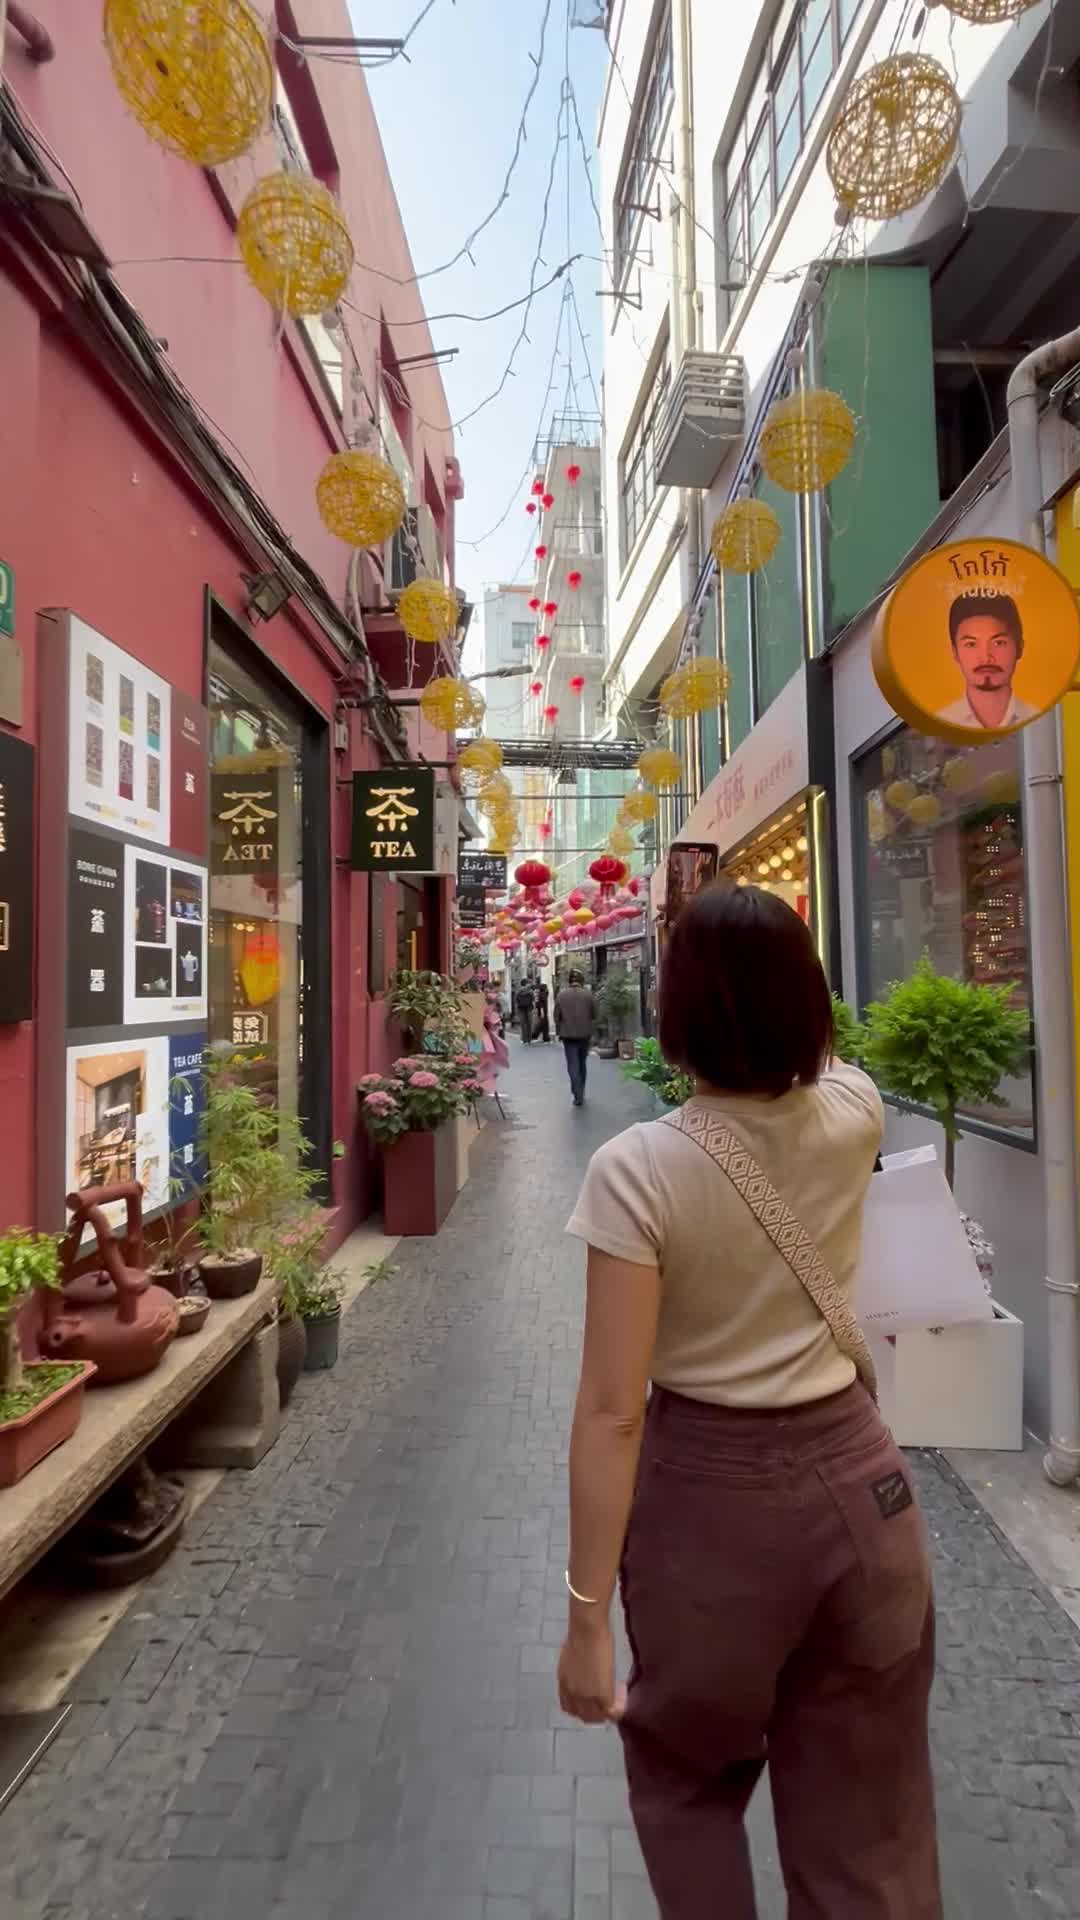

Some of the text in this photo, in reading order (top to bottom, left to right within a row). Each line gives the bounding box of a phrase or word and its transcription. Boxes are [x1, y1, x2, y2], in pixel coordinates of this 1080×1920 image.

[365, 786, 419, 832] 茶
[370, 841, 417, 858] TEA
[173, 1052, 203, 1068] TEA CAFE
